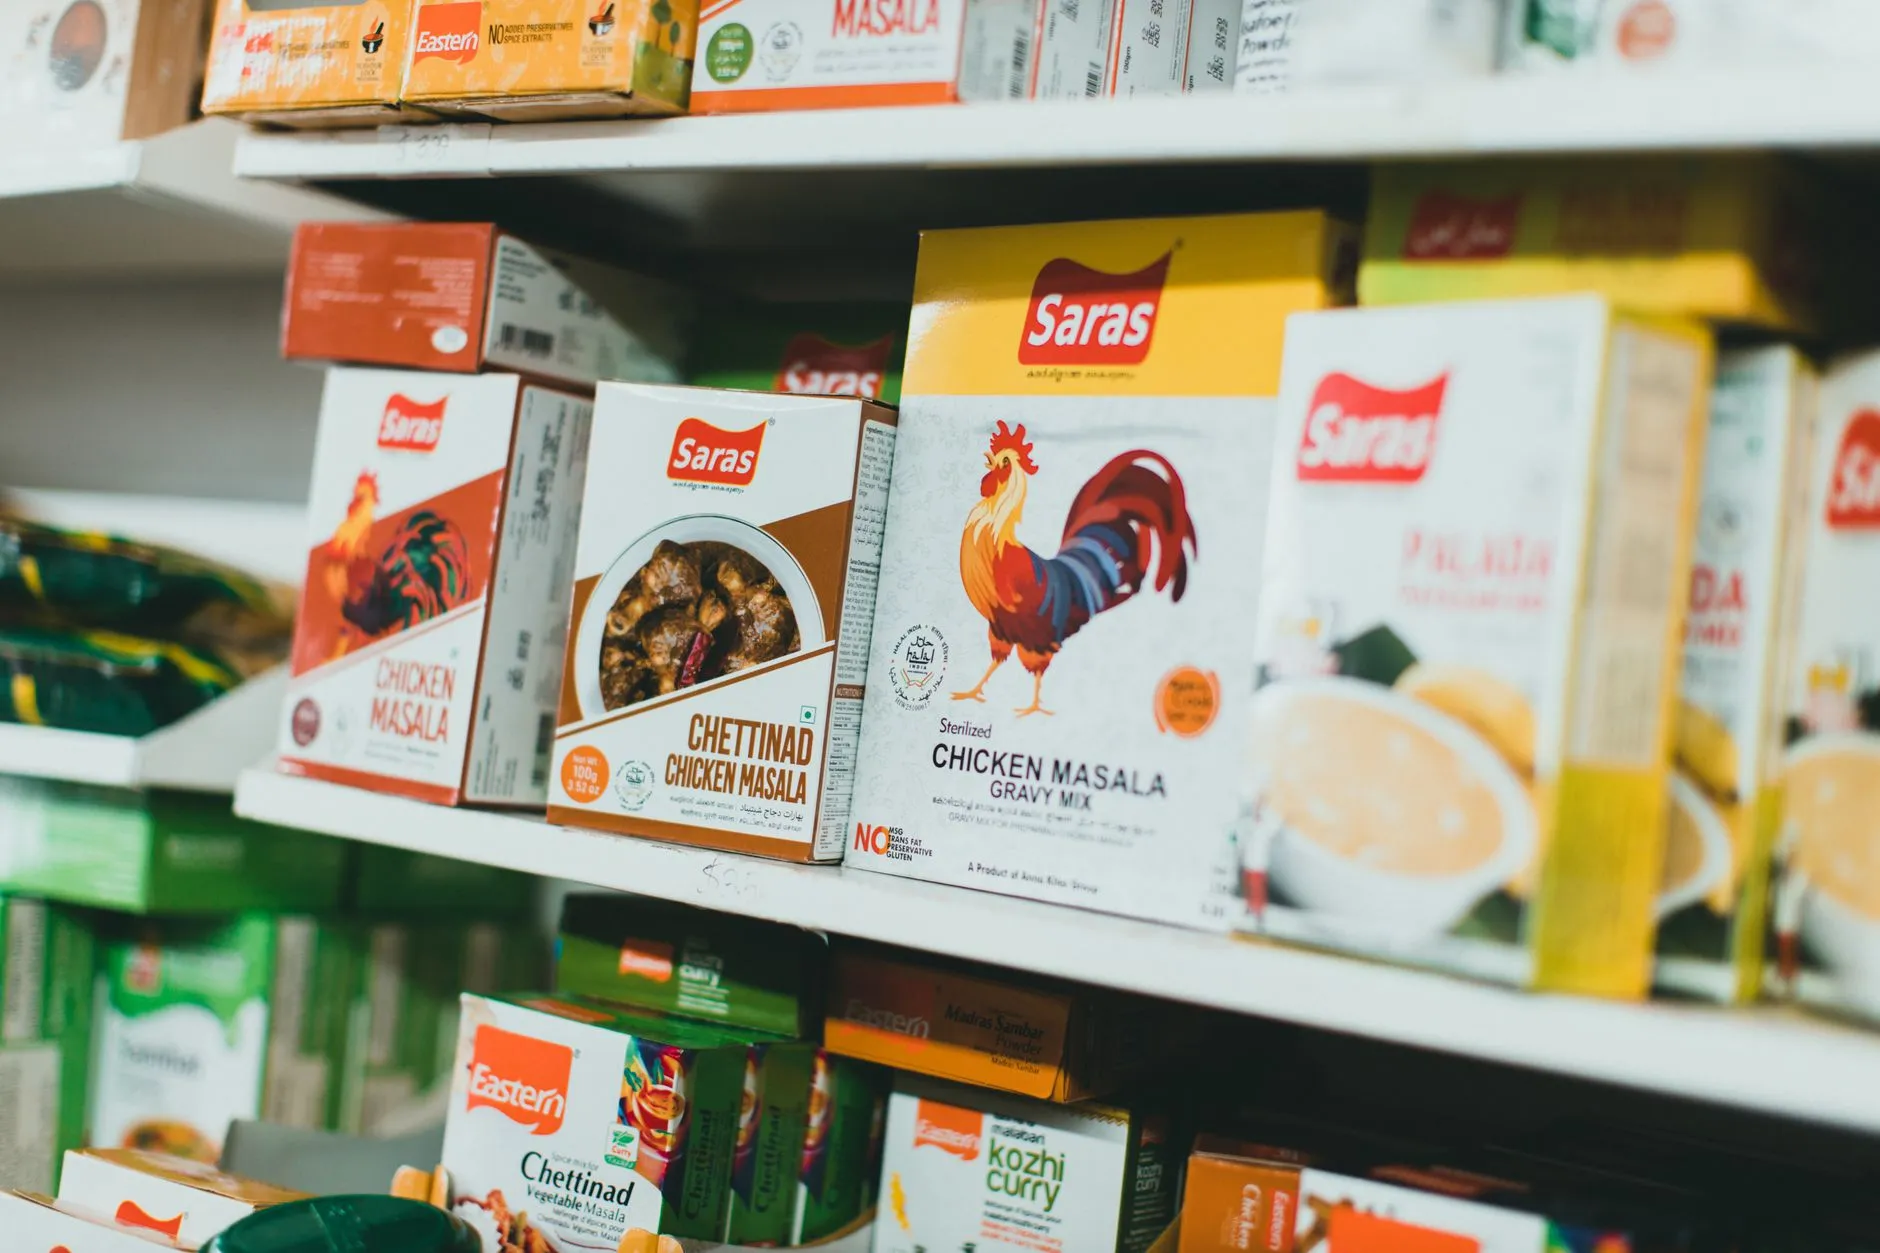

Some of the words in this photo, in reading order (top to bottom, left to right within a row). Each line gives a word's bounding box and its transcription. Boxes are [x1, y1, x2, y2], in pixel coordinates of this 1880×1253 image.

[488, 25, 504, 45] NO
[504, 25, 524, 34] ADDED
[832, 0, 940, 38] MASALA
[416, 31, 478, 53] Eastern
[503, 34, 520, 44] SPICE
[1027, 293, 1155, 347] Saras
[380, 408, 440, 443] Saras
[1299, 402, 1437, 471] Saras
[673, 437, 755, 474] Saras
[907, 624, 922, 635] INDIA
[376, 656, 457, 700] CHICKEN
[369, 697, 449, 744] MASALA
[939, 718, 992, 739] Sterilized
[688, 713, 814, 767] CHETTINAD
[665, 753, 740, 795] CHICKEN
[738, 766, 807, 805] MASALA
[932, 743, 1043, 783] CHICKEN
[1051, 758, 1167, 798] MASALA
[990, 780, 1054, 806] GRAVY
[1059, 791, 1093, 811] MIX
[854, 822, 889, 855] NO
[888, 835, 908, 845] TRANS
[910, 838, 922, 846] FAT
[889, 827, 903, 835] MSG
[886, 851, 912, 861] GLUTEN
[887, 843, 933, 857] PRESERVATIVE
[976, 862, 1008, 878] Product
[845, 999, 930, 1039] Eastern
[944, 1002, 993, 1030] Madras
[994, 1012, 1045, 1040] Sambar
[995, 1035, 1043, 1056] Powder
[470, 1062, 566, 1119] Eastern
[988, 1137, 1066, 1182] kozhi
[520, 1151, 635, 1207] Chettinad
[986, 1169, 1060, 1212] curry
[526, 1184, 583, 1212] Vegetable
[583, 1201, 626, 1224] Masala
[1238, 1184, 1262, 1250] Chicken
